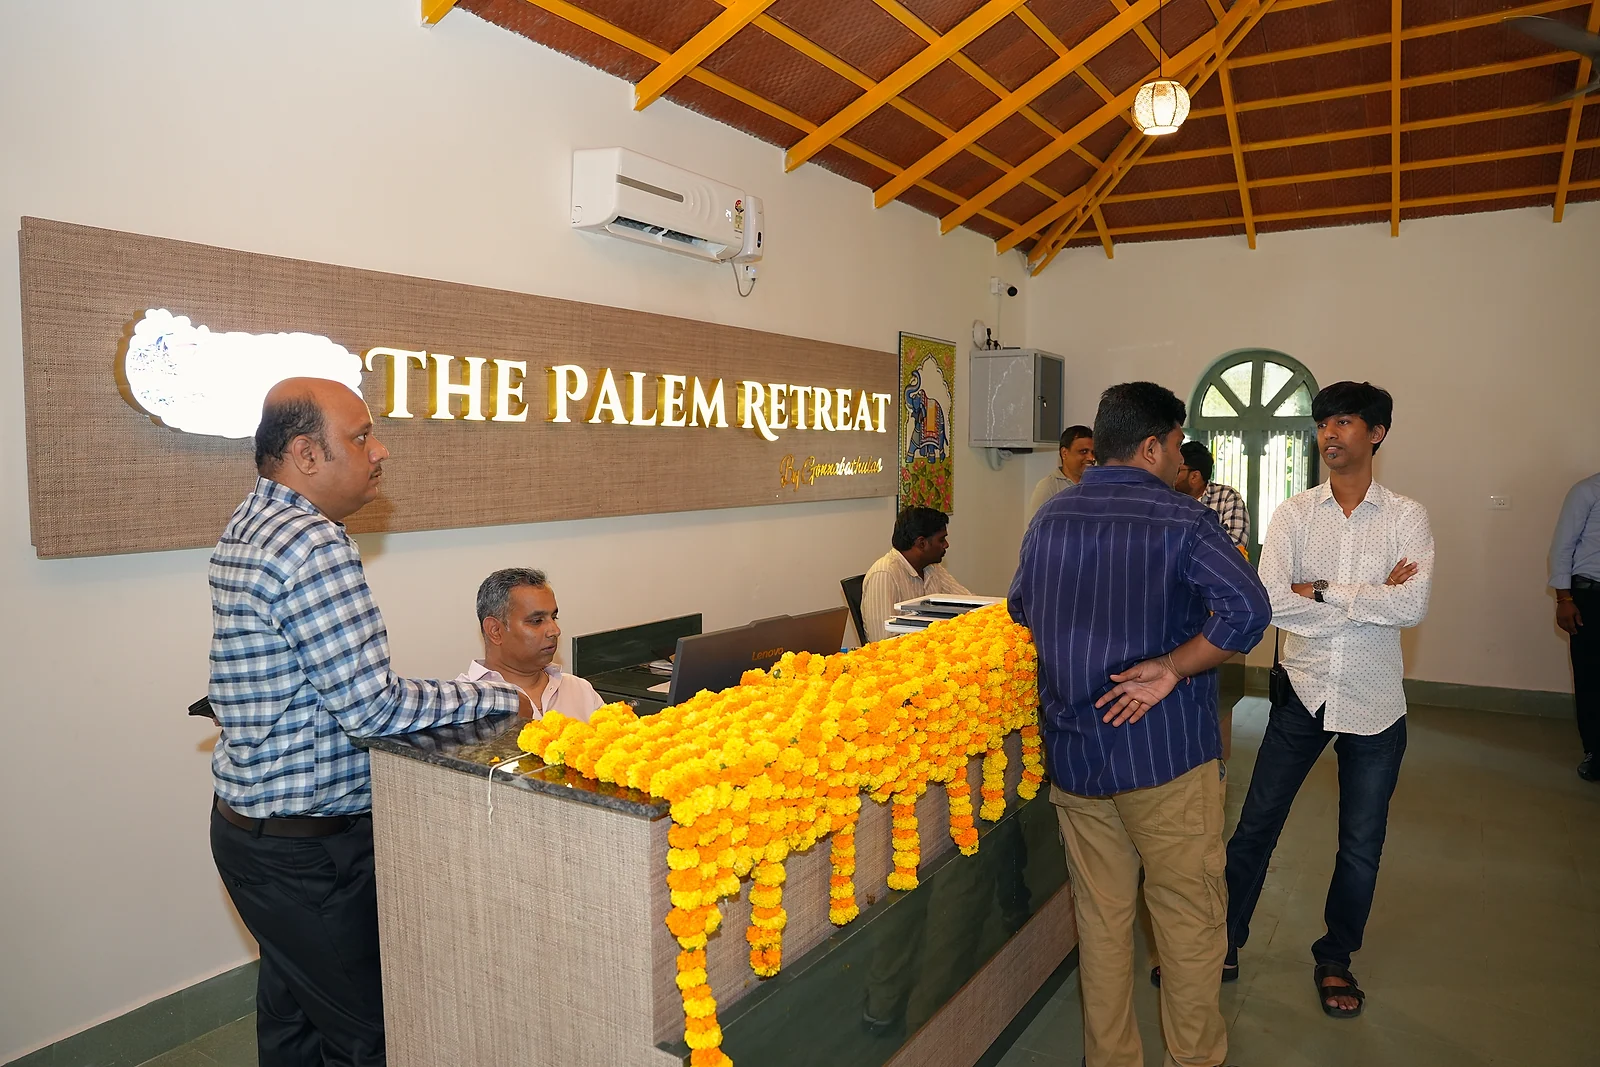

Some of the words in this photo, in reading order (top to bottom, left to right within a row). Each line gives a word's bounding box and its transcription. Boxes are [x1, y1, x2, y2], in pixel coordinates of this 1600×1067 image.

[364, 346, 528, 422] THE
[550, 364, 729, 428] PALEM
[740, 380, 892, 442] RETREAT
[780, 453, 800, 492] By
[752, 646, 784, 661] Lenovo
